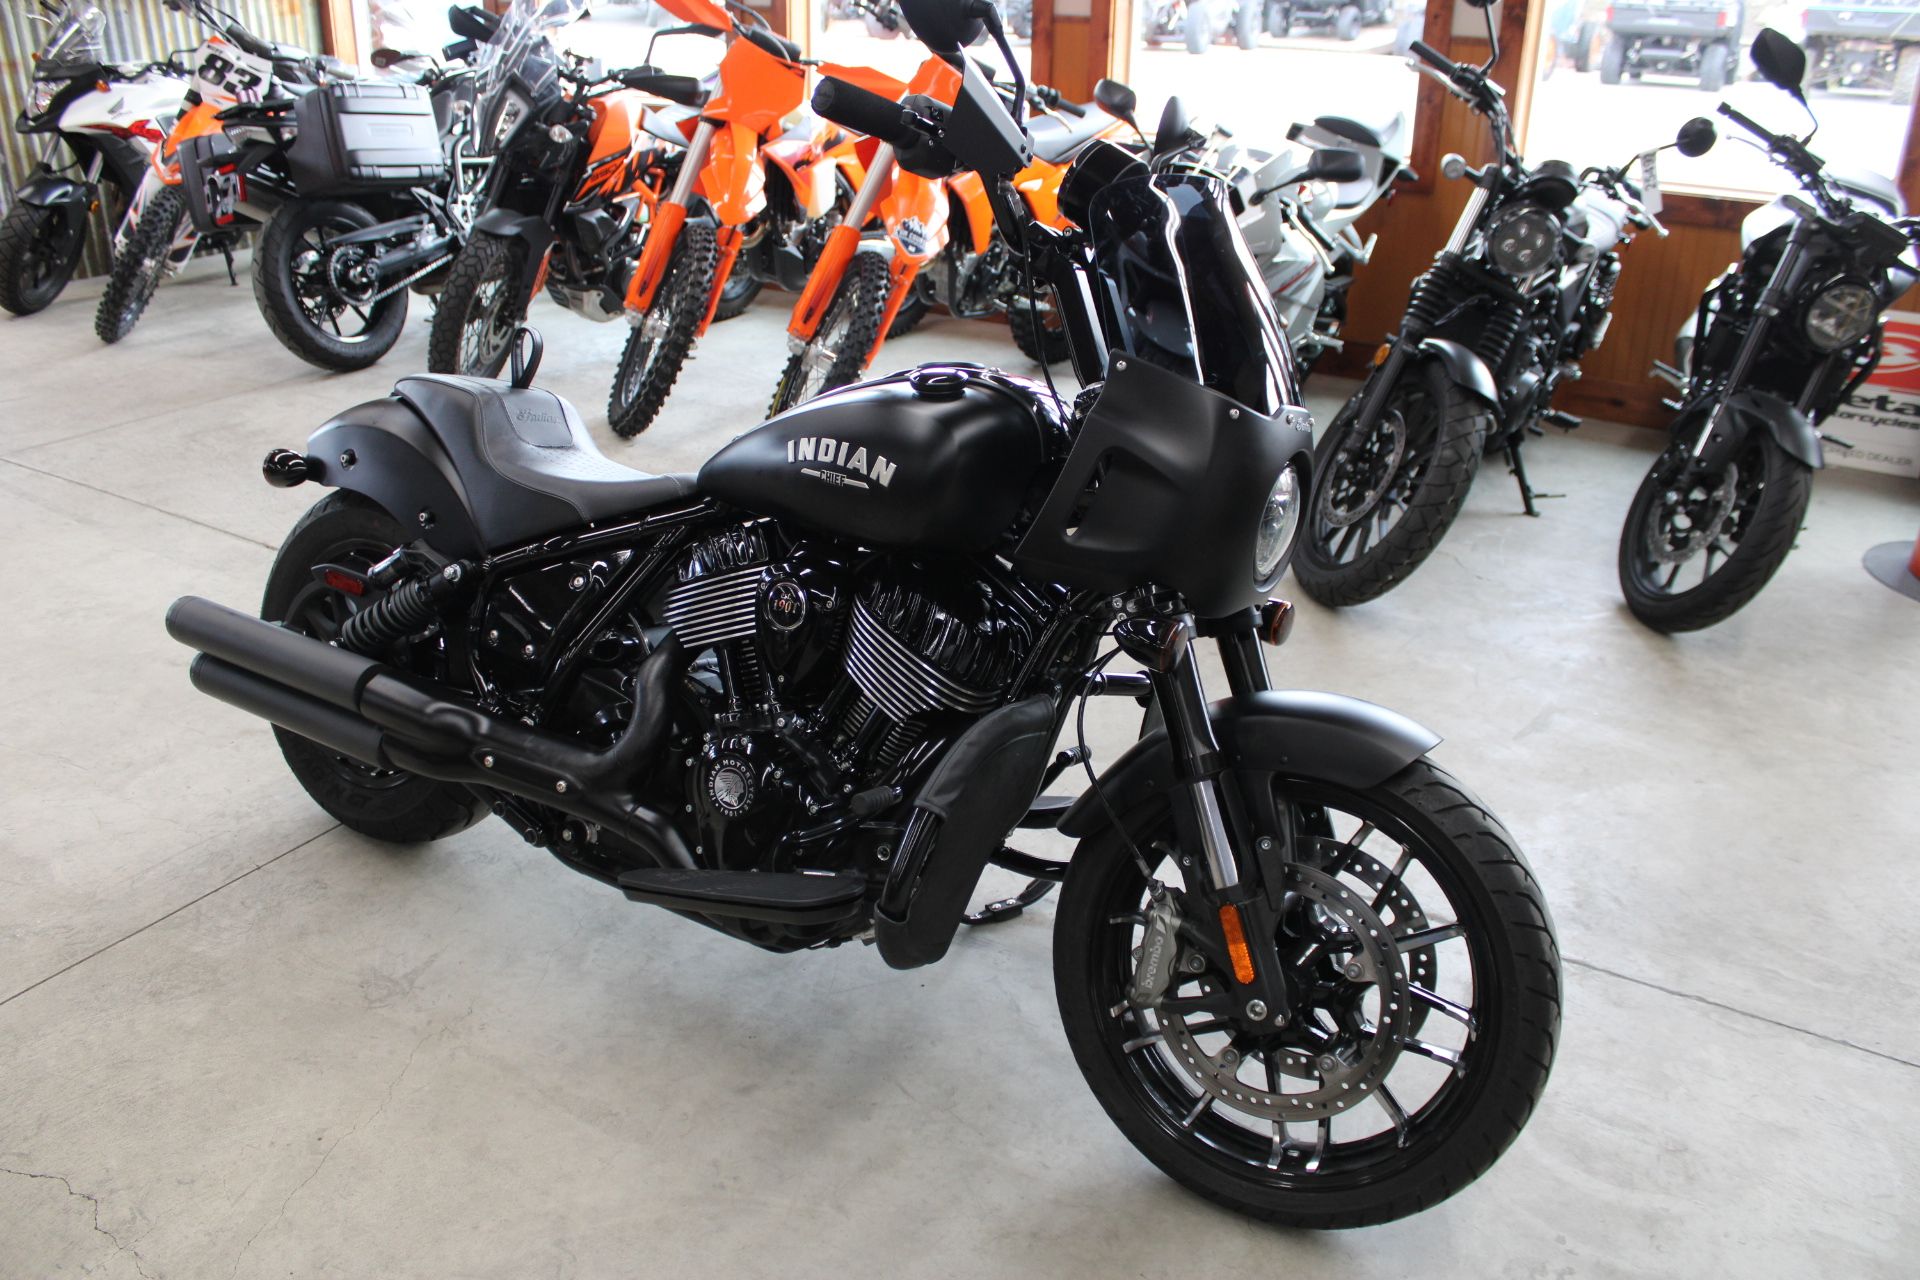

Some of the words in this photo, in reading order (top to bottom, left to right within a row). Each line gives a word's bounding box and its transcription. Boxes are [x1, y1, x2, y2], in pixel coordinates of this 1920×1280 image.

[198, 53, 262, 95] 83
[1838, 411, 1920, 430] orcycles
[1847, 395, 1920, 417] eta
[787, 437, 897, 488] INDIAN
[820, 470, 847, 487] CHIEF
[708, 763, 721, 801] INDIAN
[722, 759, 755, 811] MOTORCYCLE
[1142, 936, 1164, 988] brembo
